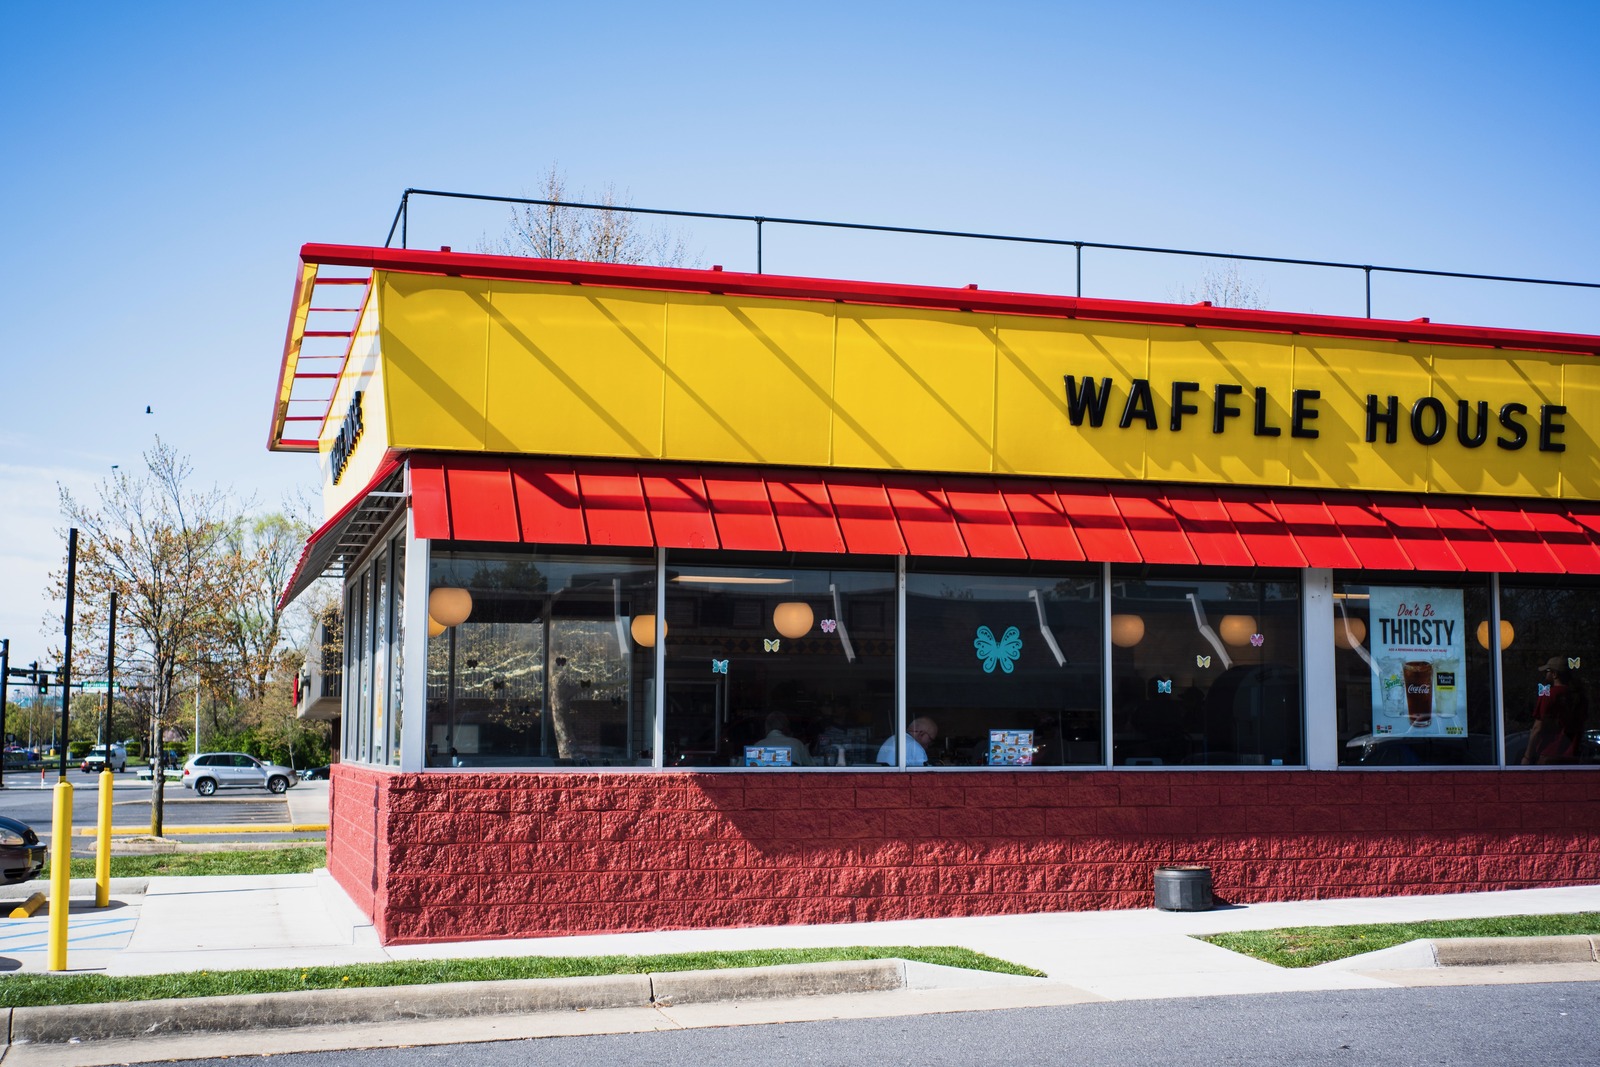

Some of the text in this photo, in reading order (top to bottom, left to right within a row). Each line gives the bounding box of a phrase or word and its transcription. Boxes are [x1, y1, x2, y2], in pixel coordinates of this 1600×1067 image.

[1064, 374, 1568, 453] WAFFLE HOUSE
[1397, 603, 1436, 617] Don't Be
[1379, 618, 1455, 646] THIRSTY
